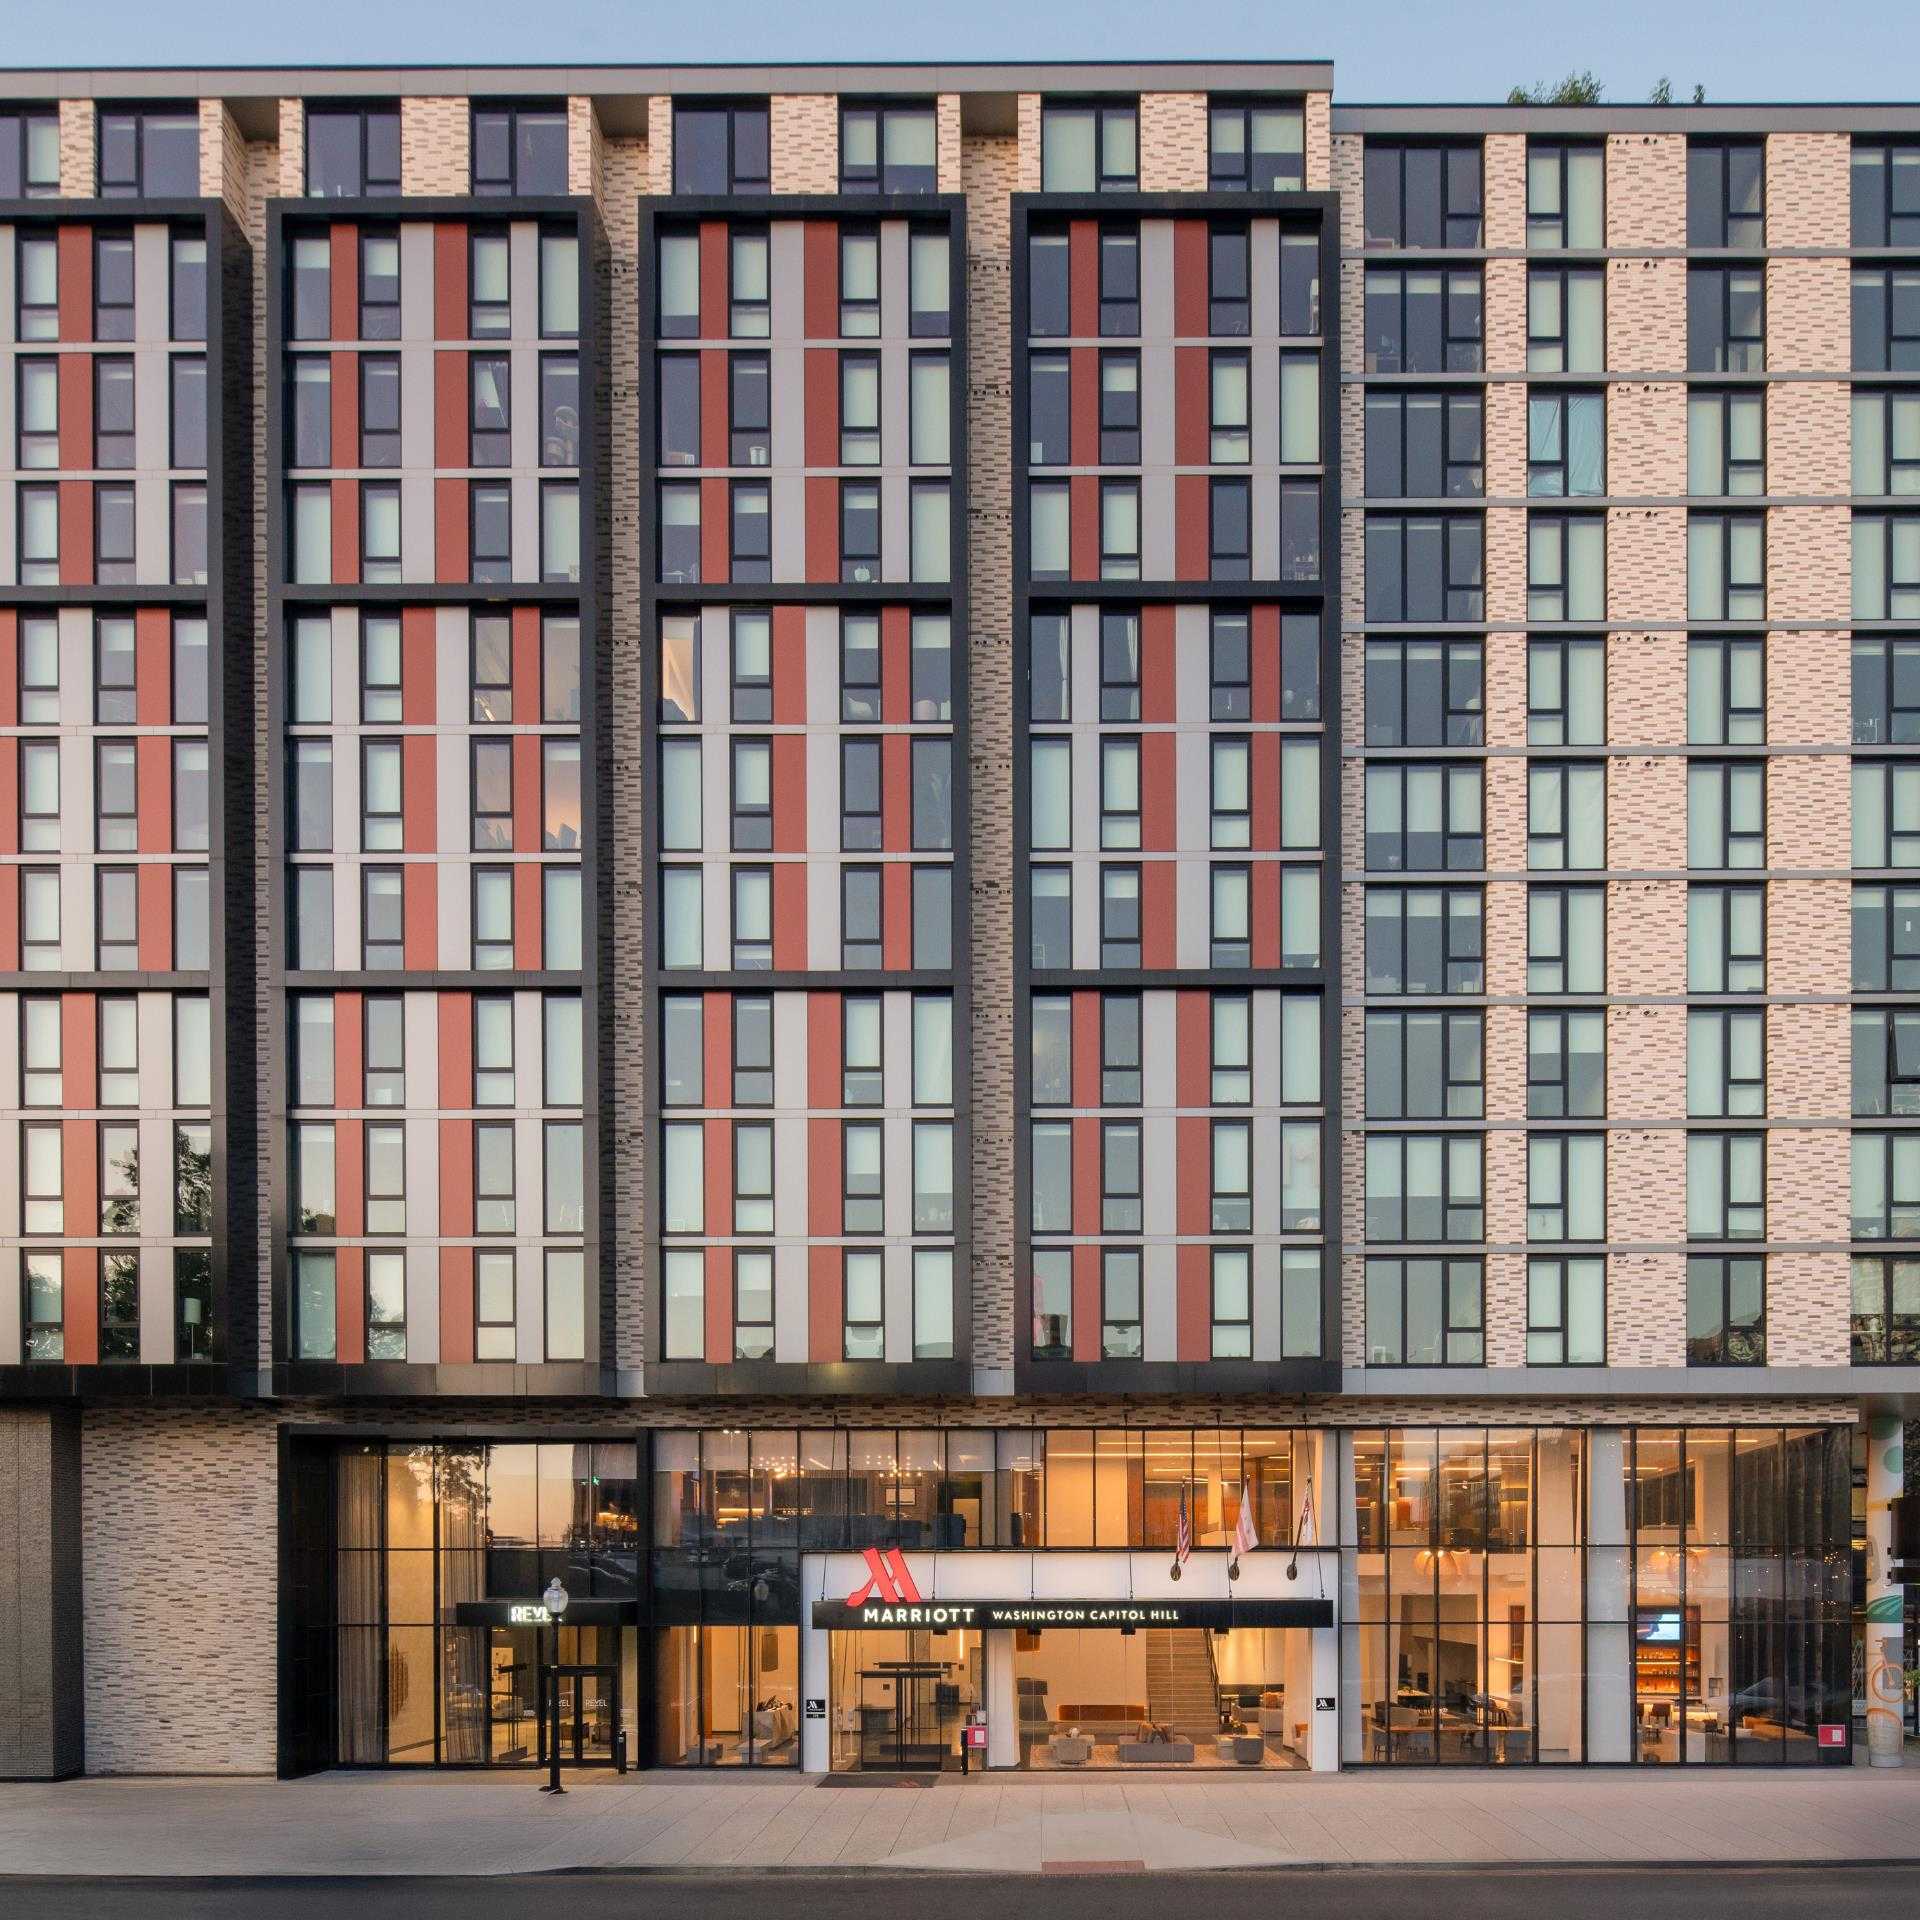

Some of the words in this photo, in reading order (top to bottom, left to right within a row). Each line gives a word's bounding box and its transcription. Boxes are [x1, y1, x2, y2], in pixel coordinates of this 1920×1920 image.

[863, 1608, 975, 1623] MARRIOTT
[992, 1610, 1085, 1621] WASHINGTON
[1089, 1610, 1145, 1621] CAPITOL
[1150, 1610, 1179, 1621] HILL
